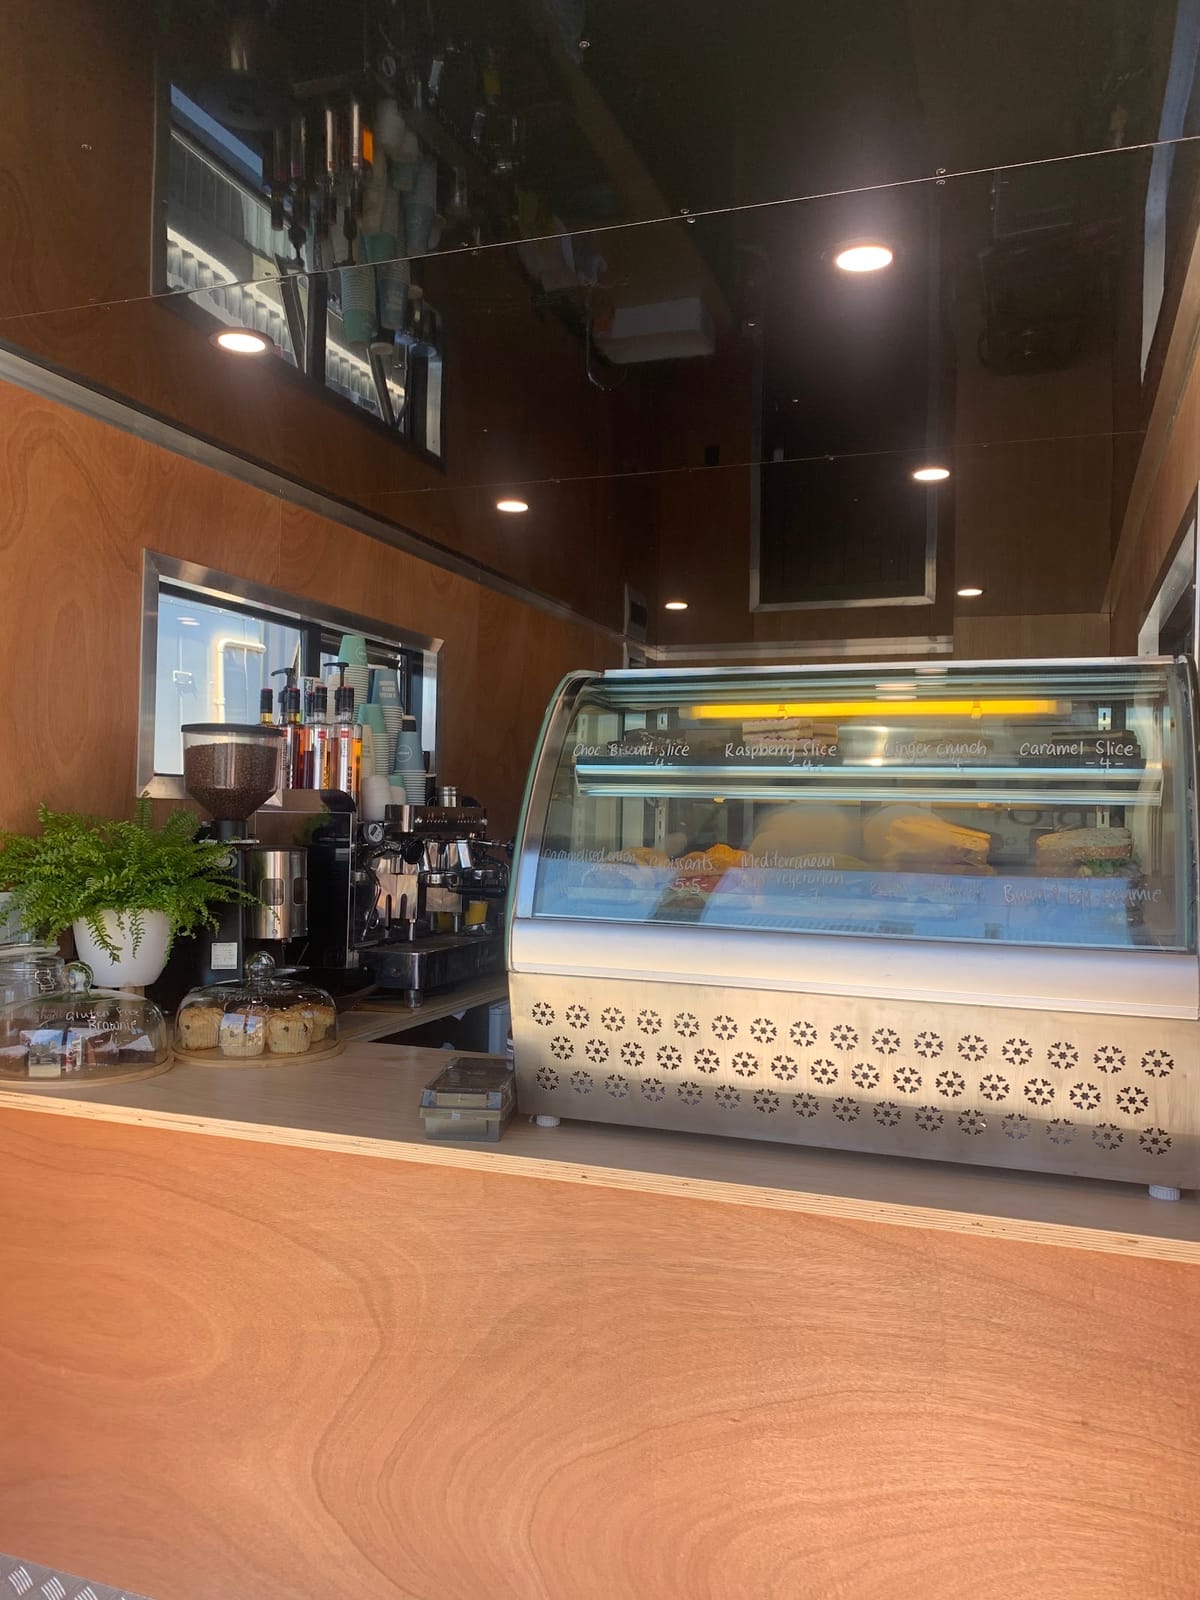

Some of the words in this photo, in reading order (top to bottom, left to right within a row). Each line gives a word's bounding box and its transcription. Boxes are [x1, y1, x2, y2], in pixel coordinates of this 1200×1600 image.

[572, 742, 601, 757] Choc
[725, 742, 796, 763] Raspberry
[1020, 740, 1083, 756] Caramel
[649, 855, 714, 871] Coissants
[741, 849, 836, 869] Mediterranean
